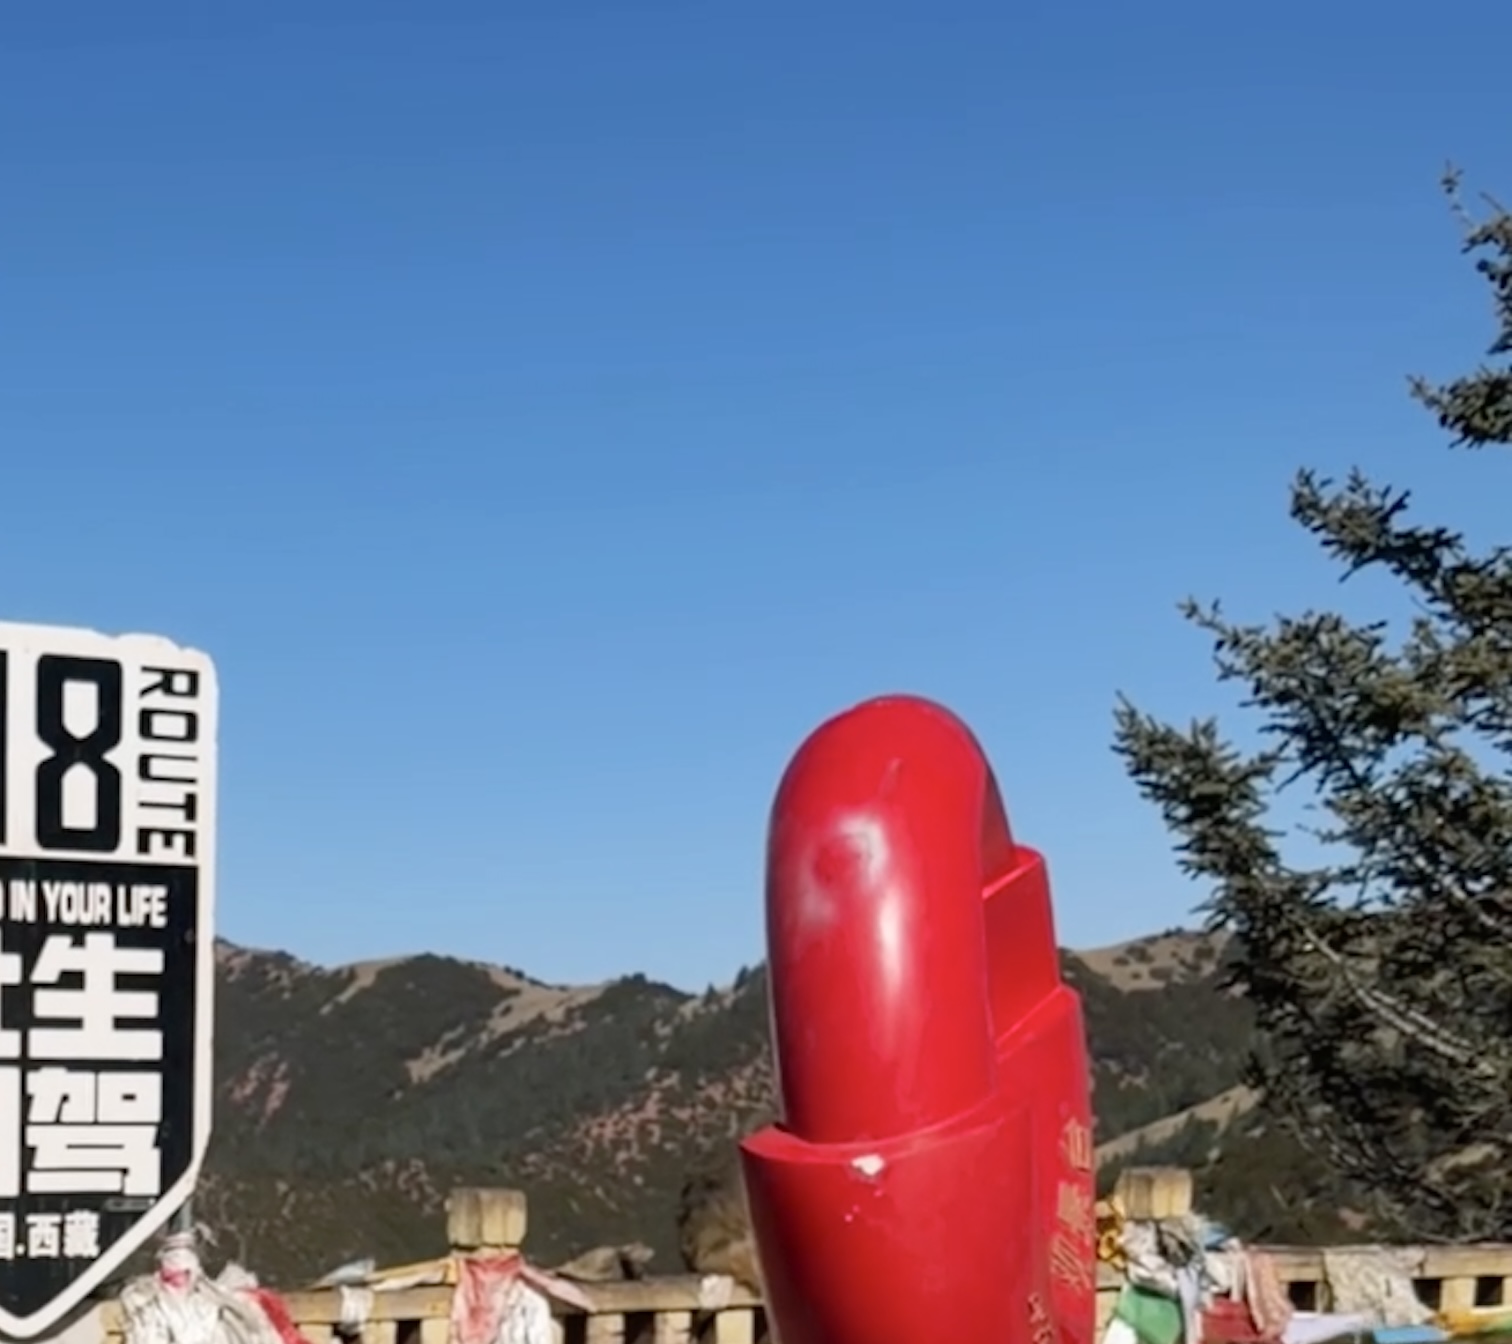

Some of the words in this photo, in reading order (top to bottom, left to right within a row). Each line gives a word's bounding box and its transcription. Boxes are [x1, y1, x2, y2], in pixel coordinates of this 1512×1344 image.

[136, 665, 200, 859] ROUTE
[9, 879, 37, 923] IN
[42, 881, 112, 926] YOUR
[117, 884, 169, 928] LIFE
